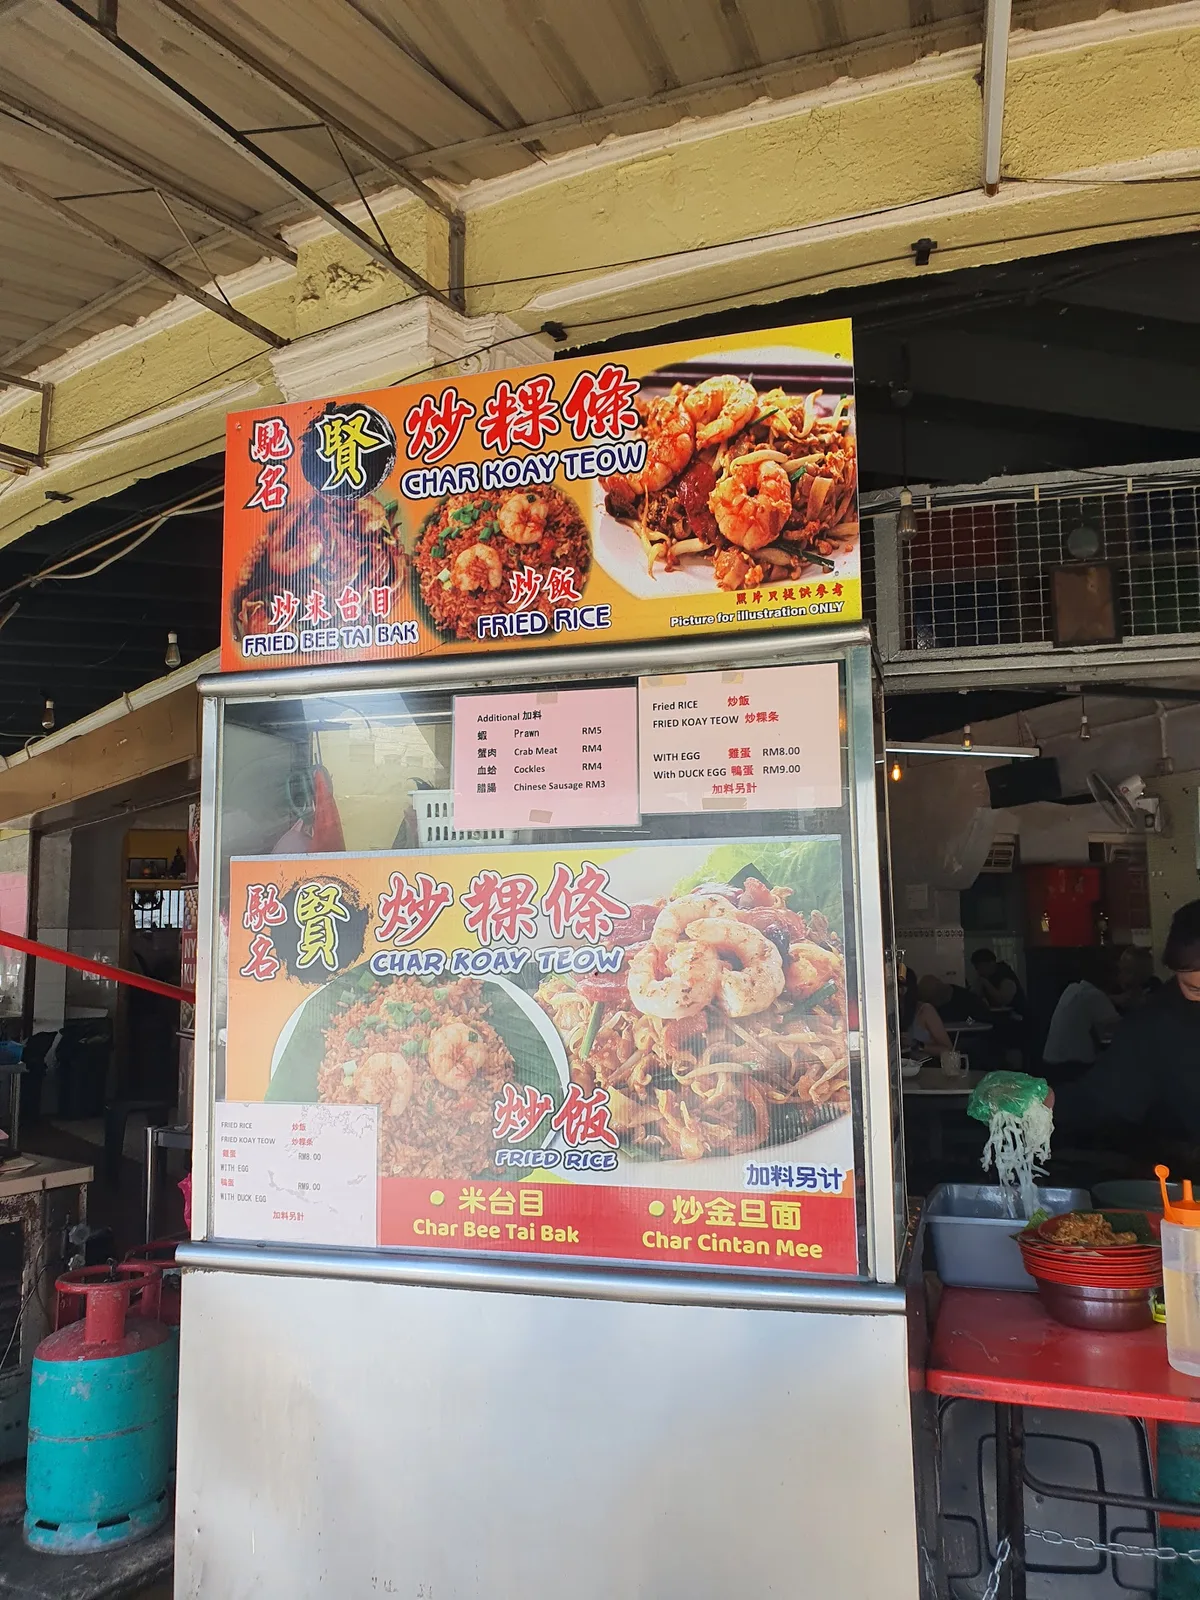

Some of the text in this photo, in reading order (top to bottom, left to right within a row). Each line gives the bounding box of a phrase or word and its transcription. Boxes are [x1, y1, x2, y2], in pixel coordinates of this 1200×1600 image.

[404, 366, 641, 462] 炒粿條
[320, 413, 386, 488] 賢
[402, 444, 646, 497] CHAR KOAY TEOW
[508, 566, 582, 611] 炒飯
[478, 605, 611, 638] FRIED RICE
[670, 601, 844, 628] Picture for illustration ONLY
[243, 621, 419, 655] FRIED BEE TAI BAK
[652, 695, 750, 711] Fried RICE 炒飯
[477, 709, 542, 723] Additional 加料
[653, 718, 679, 729] FRIED
[681, 717, 708, 727] KOAY
[710, 715, 739, 725] TEOW
[514, 728, 540, 738] Prawn
[582, 726, 602, 735] RM5
[514, 747, 533, 756] Crab
[535, 746, 558, 755] Meat
[582, 744, 602, 753] RM4
[653, 752, 679, 762] WITH
[681, 751, 701, 761] EGG
[762, 746, 801, 757] RM8.00
[514, 764, 545, 774] Cockles
[582, 761, 602, 771] RM4
[654, 769, 676, 779] With
[678, 768, 705, 779] DUCK
[707, 767, 727, 777] EGG
[763, 764, 801, 774] RM9.00
[514, 782, 547, 792] Chinese
[549, 781, 583, 791] Sausage
[585, 780, 606, 789] RM3
[711, 782, 757, 795] 加料另計
[376, 863, 630, 945] 炒粿條
[296, 884, 349, 970] 賢
[372, 946, 624, 974] CHAR KOAY TEOW
[220, 1121, 238, 1129] FRIED
[239, 1122, 253, 1130] RICE
[257, 1137, 276, 1145] TEOW
[220, 1163, 249, 1173] WITH EGG
[496, 1150, 617, 1169] FRIED RICE
[745, 1163, 843, 1190] 加料另计
[220, 1192, 267, 1203] WITH DUCK EGG
[458, 1186, 544, 1217] 米台目
[672, 1195, 802, 1231] 炒金旦面
[413, 1218, 580, 1244] Char Bee Tai Bak
[642, 1230, 824, 1259] Char Cintan Mee
